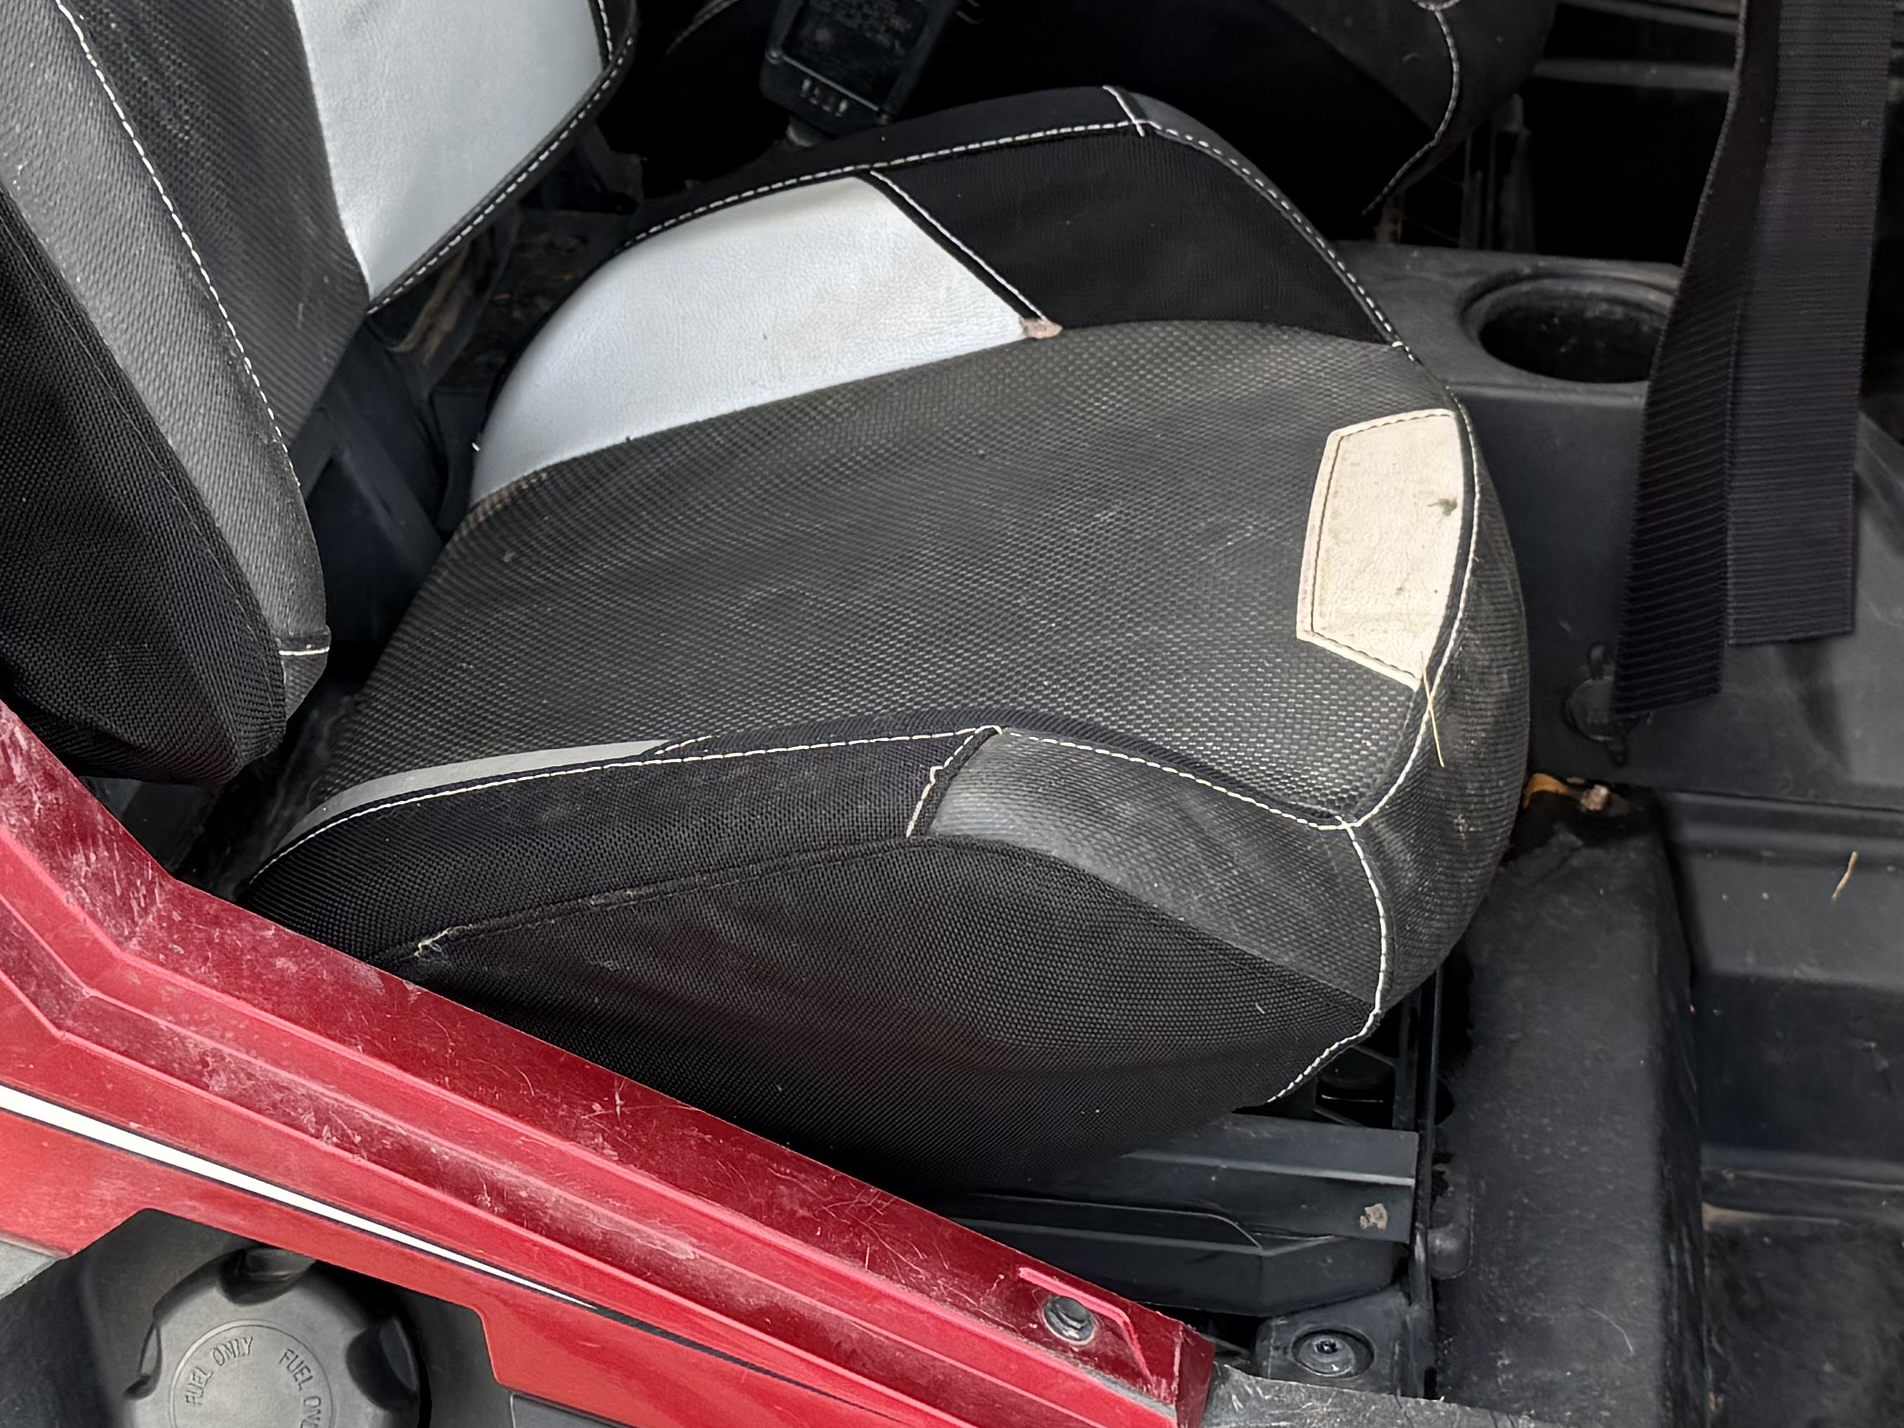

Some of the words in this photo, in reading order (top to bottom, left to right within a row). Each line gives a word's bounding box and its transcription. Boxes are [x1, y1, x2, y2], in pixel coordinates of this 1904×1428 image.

[184, 1366, 214, 1407] FUEL
[211, 1336, 254, 1367] ONLY
[278, 1347, 314, 1391] FUEL
